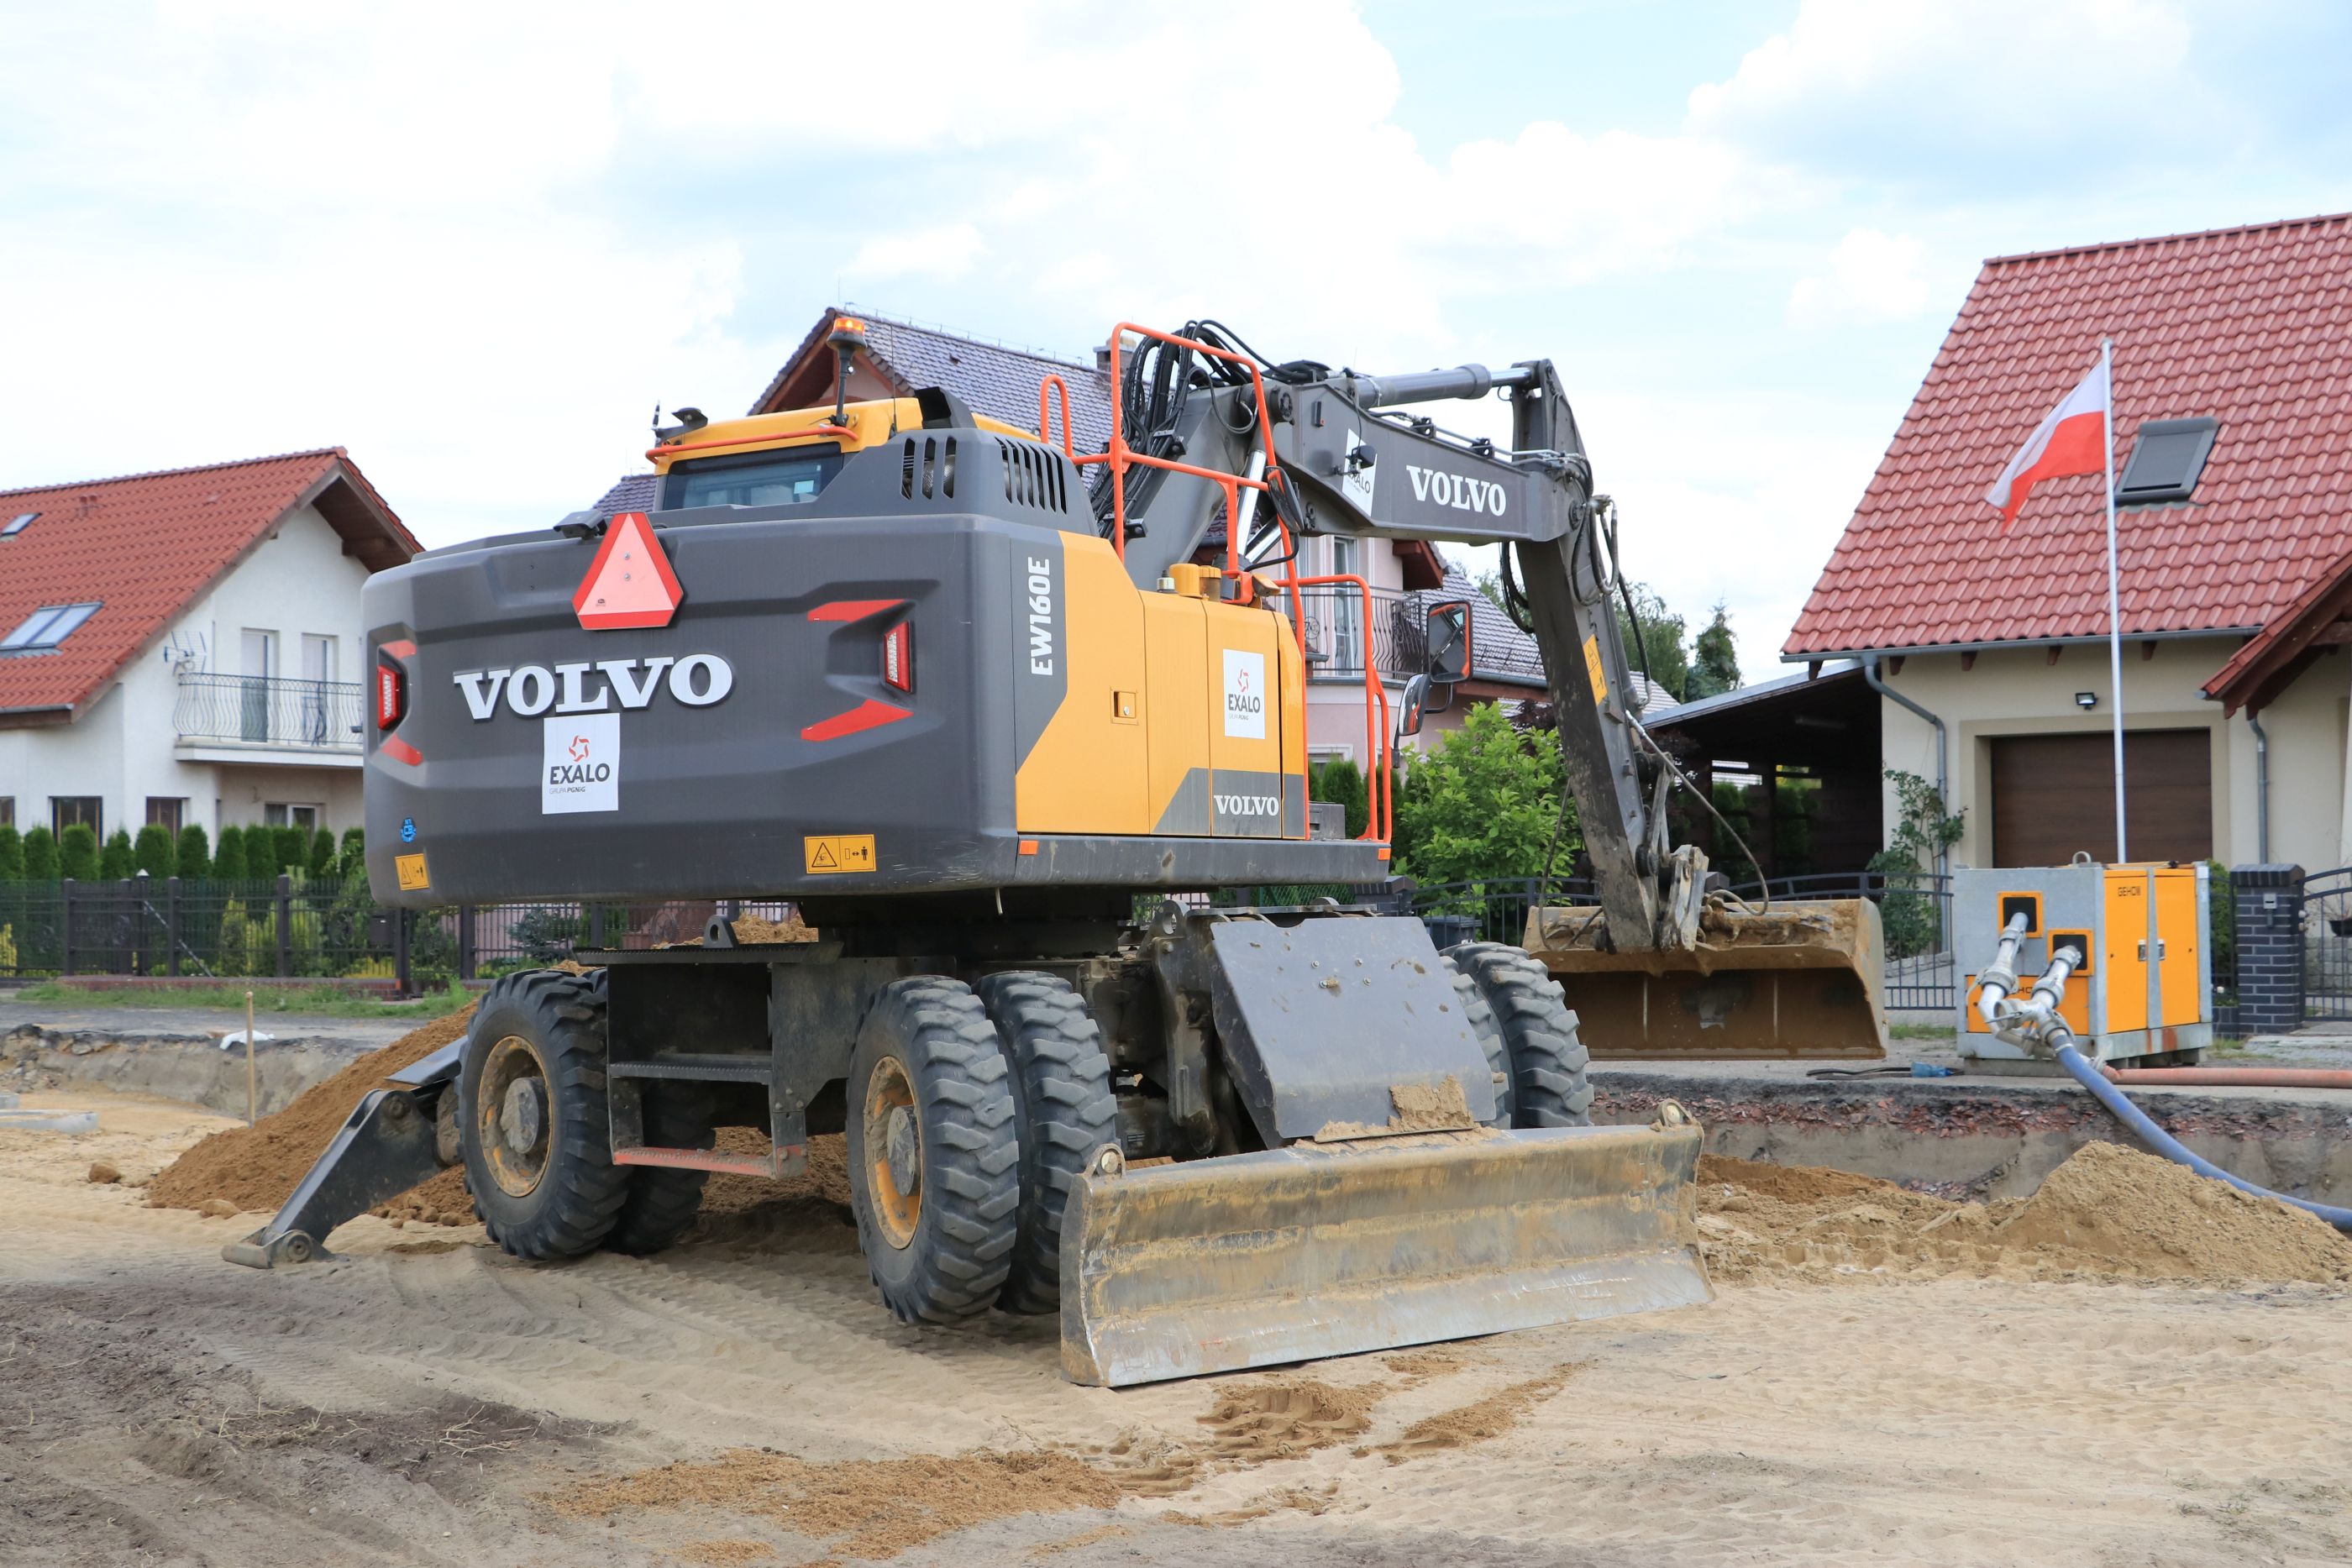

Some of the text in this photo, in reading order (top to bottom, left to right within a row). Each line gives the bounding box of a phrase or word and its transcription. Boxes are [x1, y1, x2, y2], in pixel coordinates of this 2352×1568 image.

[1406, 464, 1507, 517] VOLVO
[1027, 556, 1053, 676] EW160E
[454, 653, 732, 721] VOLVO
[1228, 694, 1261, 714] EXALO
[549, 763, 611, 785] EXALO
[1213, 794, 1279, 816] VOLVO
